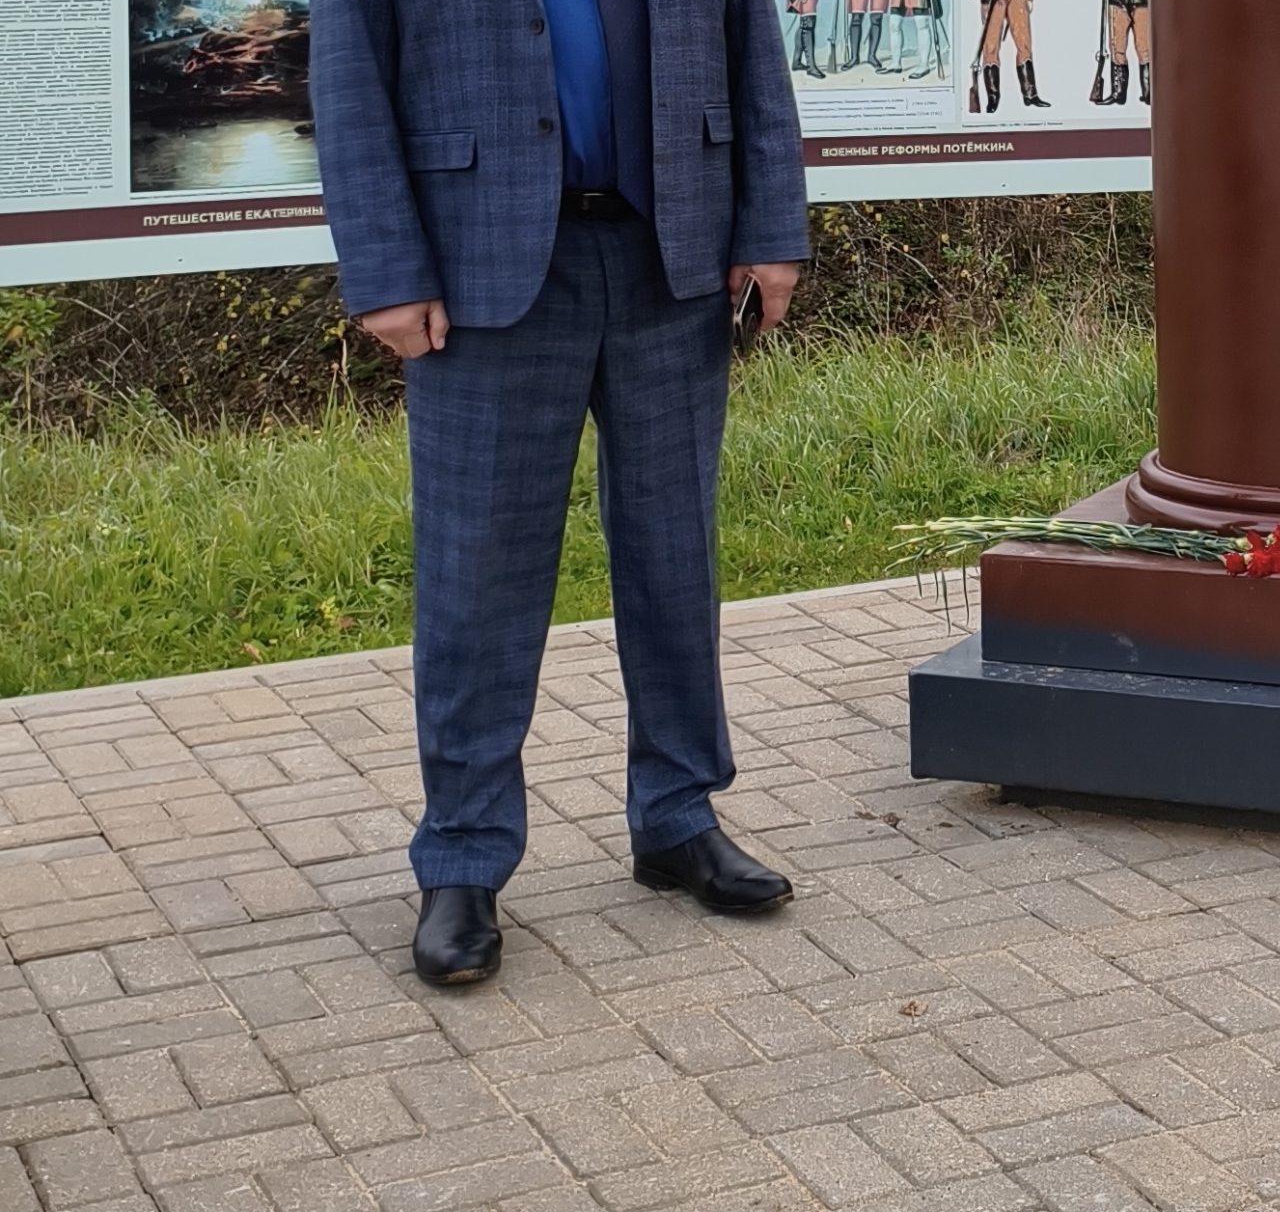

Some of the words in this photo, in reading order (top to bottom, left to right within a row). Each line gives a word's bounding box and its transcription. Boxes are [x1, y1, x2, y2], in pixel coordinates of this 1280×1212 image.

[821, 146, 878, 157] ВОЕННЫЕ
[881, 144, 941, 156] РЕФОРМЫ
[944, 141, 1015, 154] ПОТЁМКИНА
[143, 210, 242, 227] ПУТЕШЕСТВИЕ
[245, 206, 324, 220] ЕКАТЕРИНЫ
